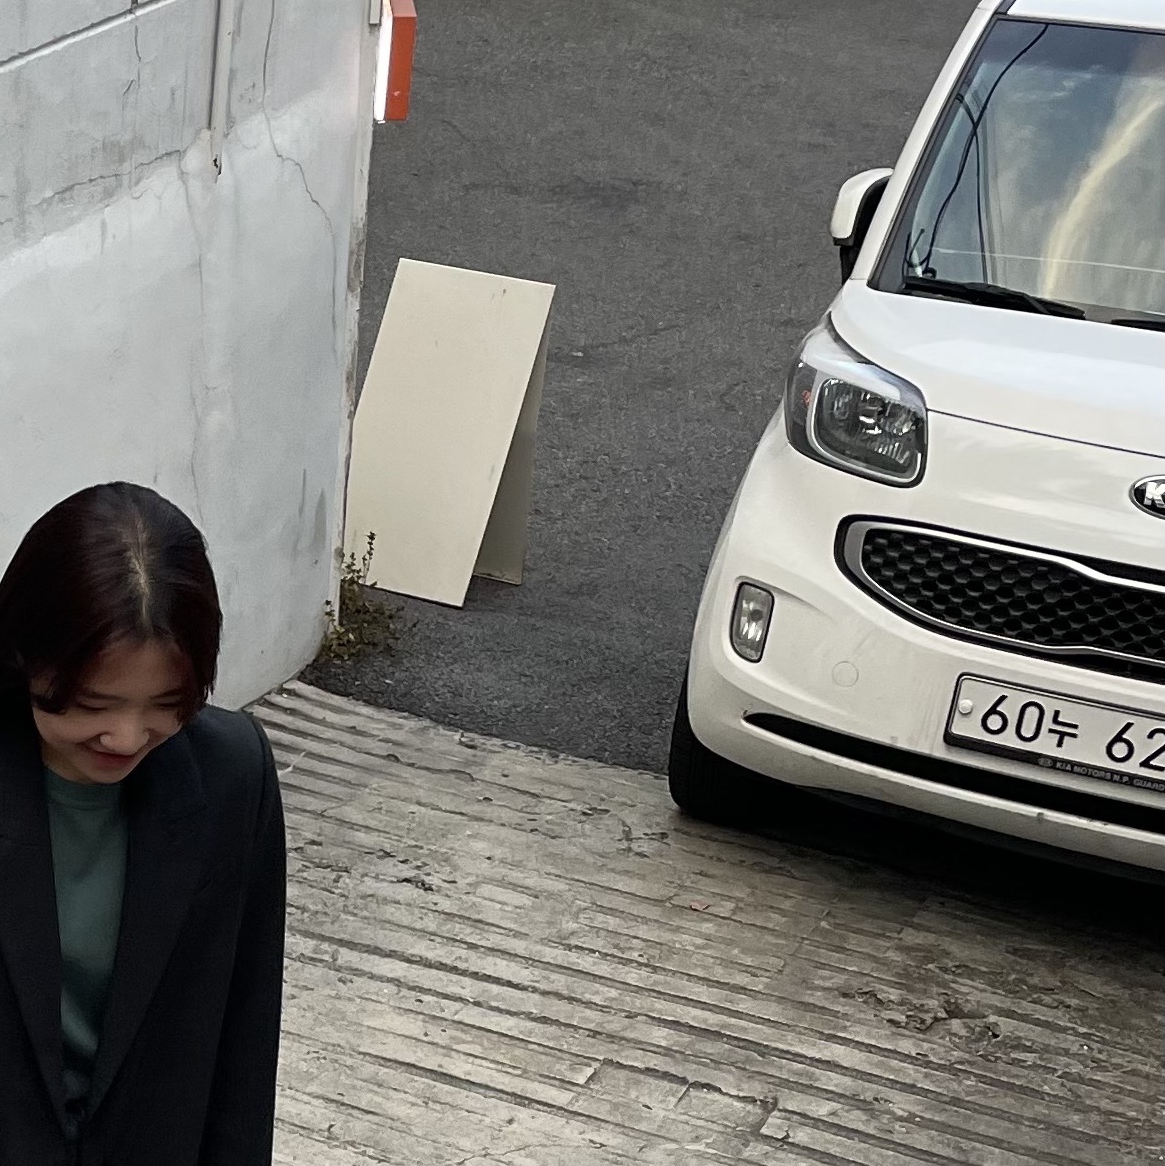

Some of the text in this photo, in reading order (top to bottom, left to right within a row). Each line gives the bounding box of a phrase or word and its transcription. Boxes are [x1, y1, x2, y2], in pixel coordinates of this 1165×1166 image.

[981, 694, 1079, 748] 60누
[1055, 761, 1072, 771] KIA
[1073, 765, 1111, 781] MOTORS
